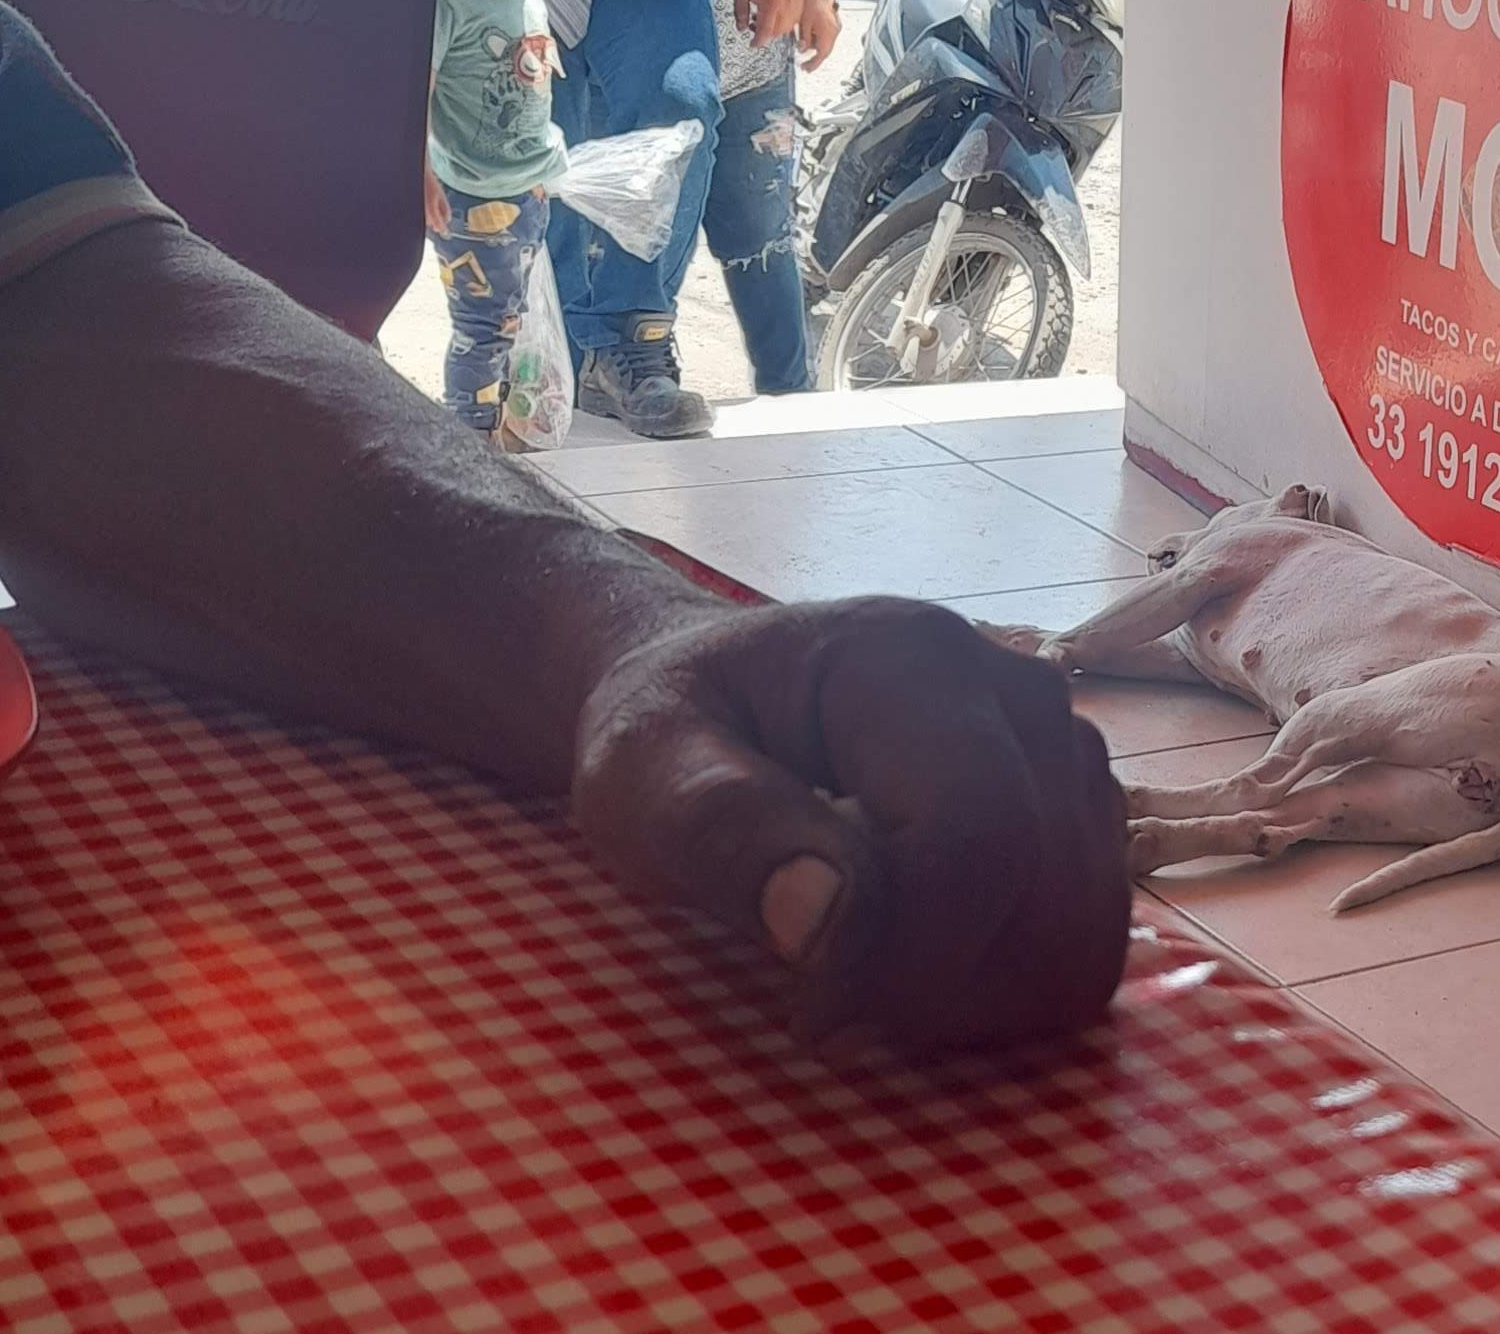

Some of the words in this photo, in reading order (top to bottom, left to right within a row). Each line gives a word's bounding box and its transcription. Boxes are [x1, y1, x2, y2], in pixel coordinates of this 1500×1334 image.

[1400, 298, 1460, 347] TACOS
[1464, 329, 1478, 355] Y
[1375, 345, 1468, 417] SERVICIO
[1471, 394, 1487, 427] A
[1367, 393, 1406, 461] 33
